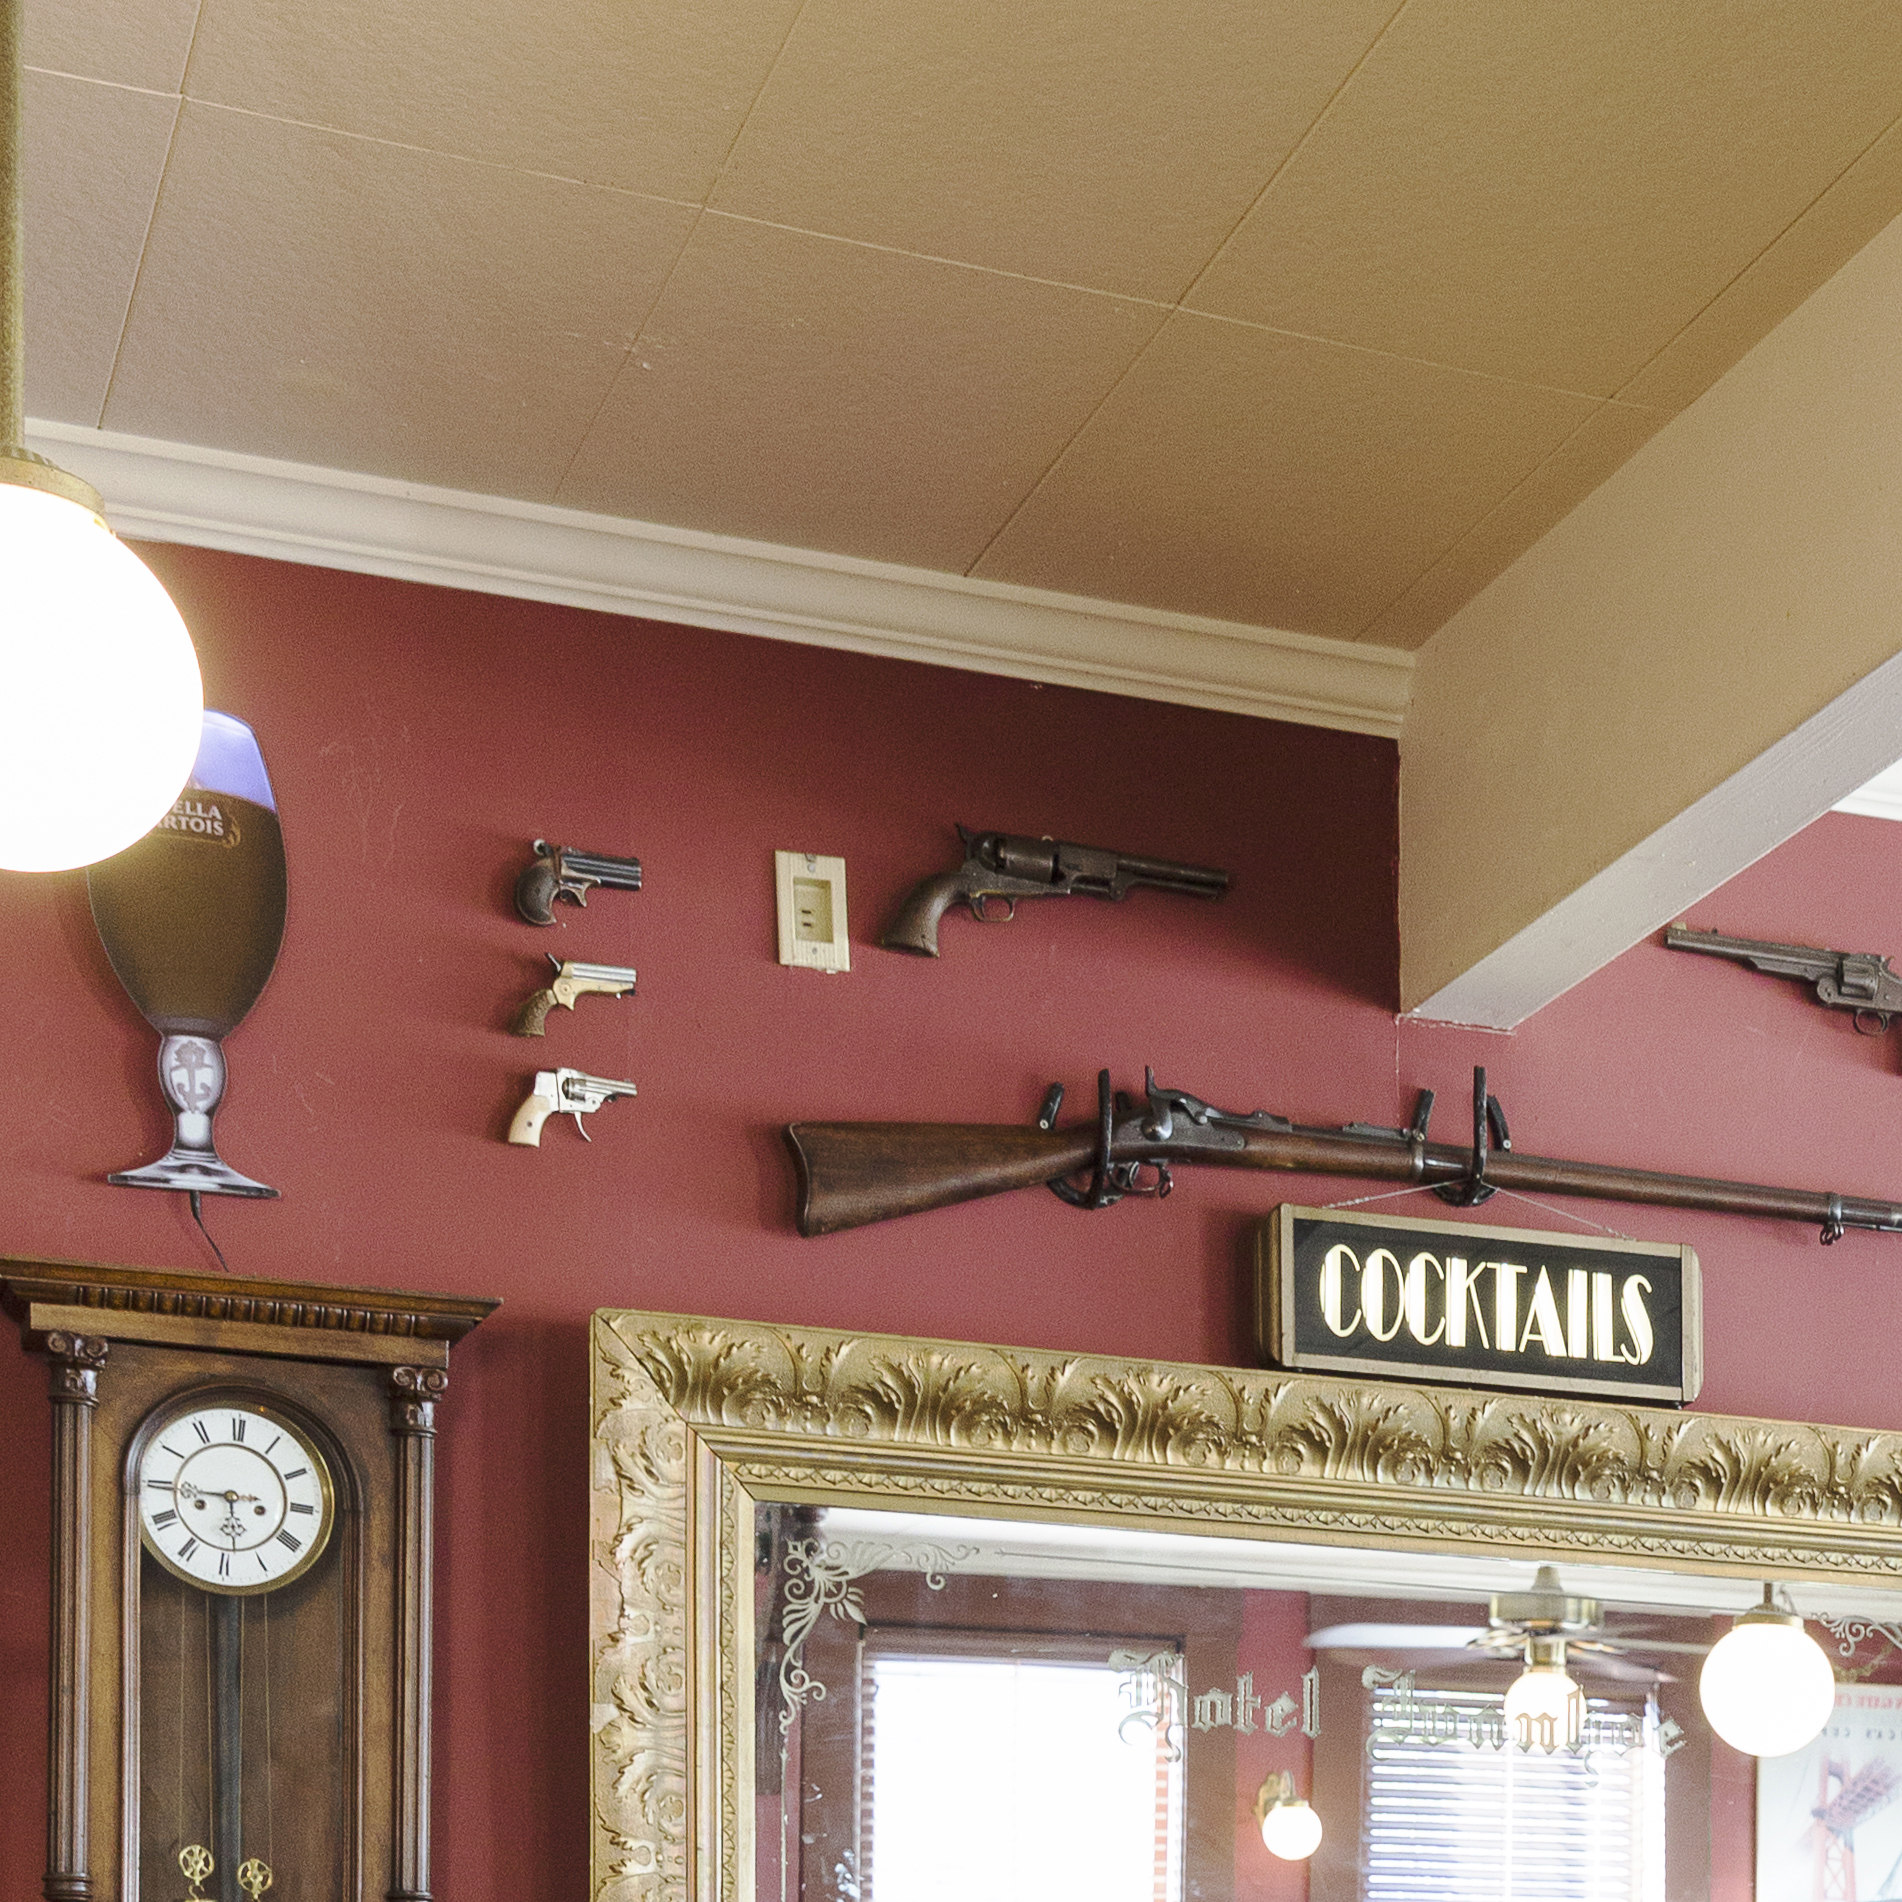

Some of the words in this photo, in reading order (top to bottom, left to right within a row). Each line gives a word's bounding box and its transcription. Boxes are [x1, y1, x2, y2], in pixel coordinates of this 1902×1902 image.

[172, 801, 222, 820] ELLA
[1319, 1243, 1654, 1366] COCKTAILS
[1107, 1649, 1322, 1763] Hotel
